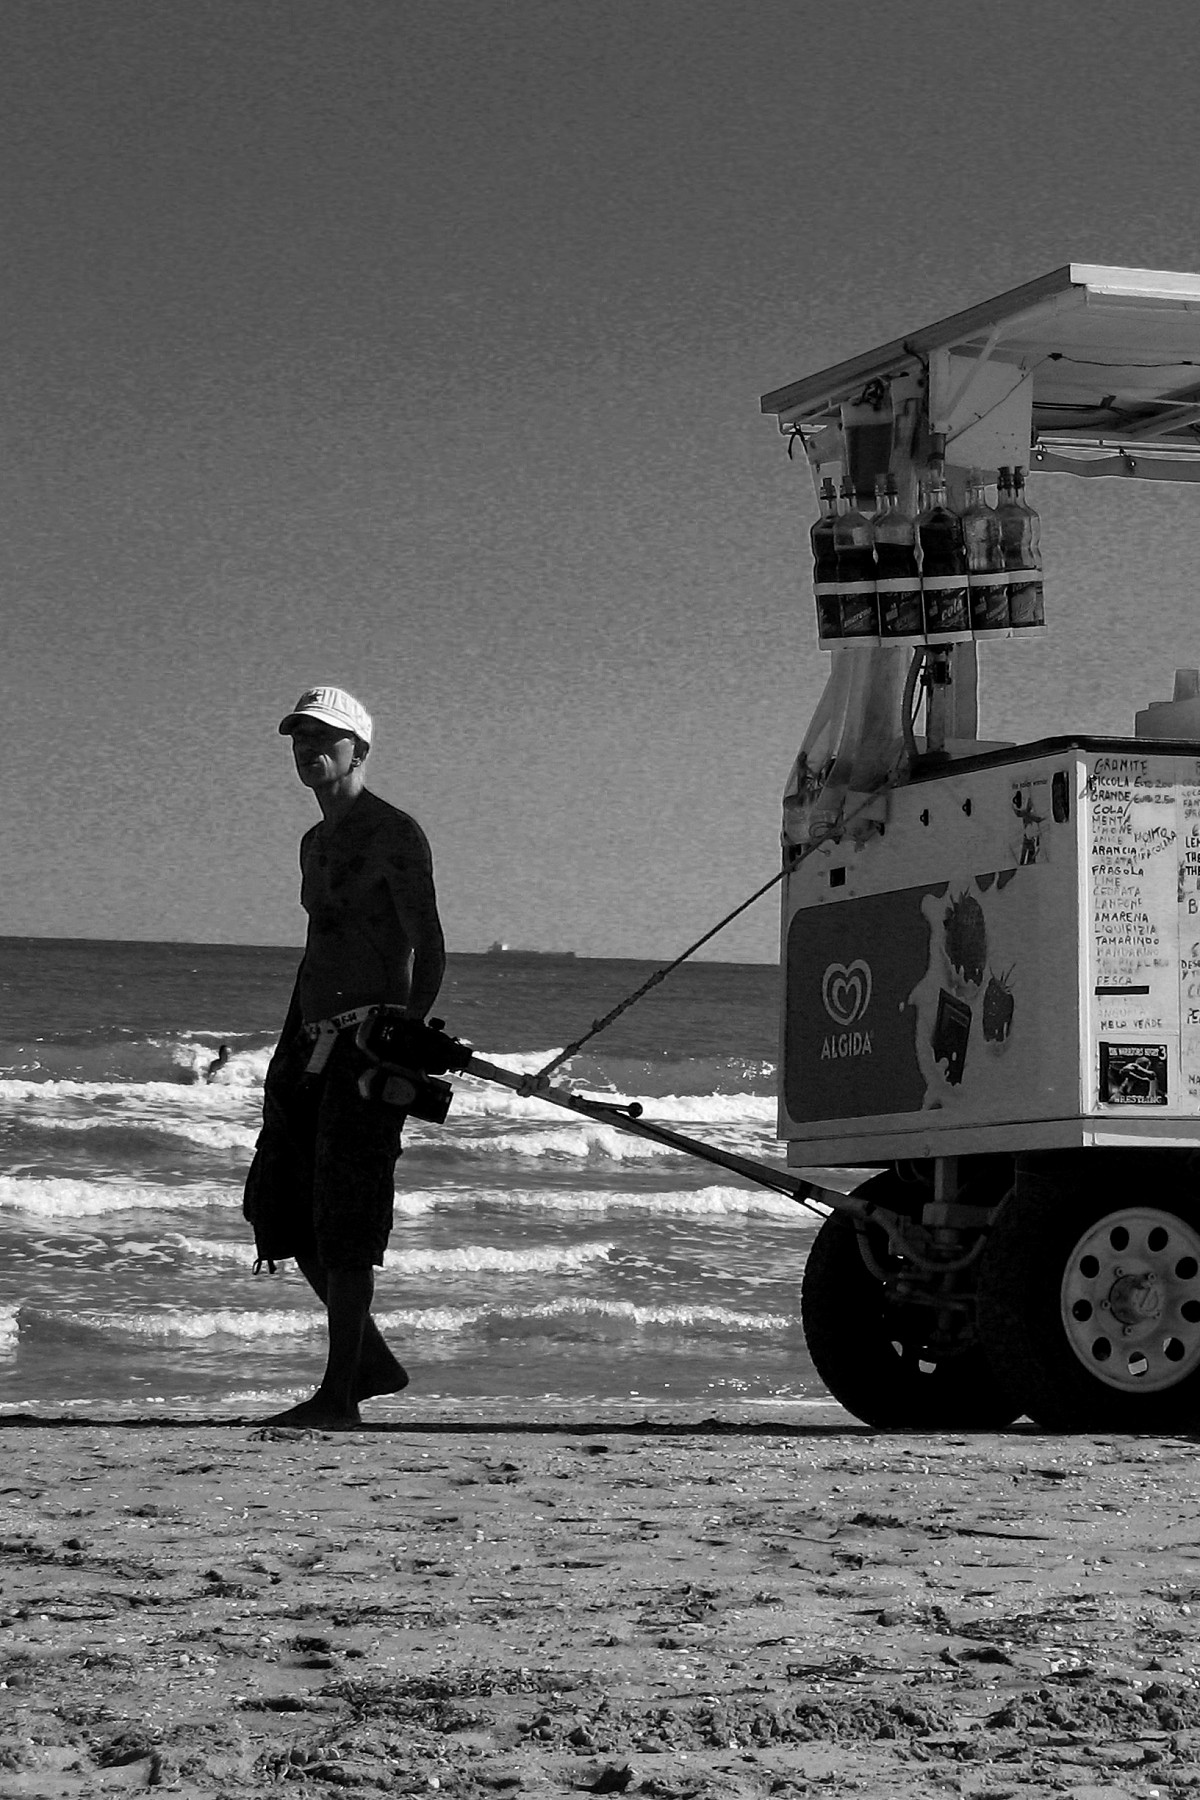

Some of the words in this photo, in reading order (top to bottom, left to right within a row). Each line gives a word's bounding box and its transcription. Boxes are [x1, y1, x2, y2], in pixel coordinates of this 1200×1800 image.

[1090, 789, 1132, 802] GRANDE
[1093, 804, 1123, 814] COLA
[1092, 825, 1132, 835] LIMONE
[1091, 845, 1138, 856] ARANCIA
[1091, 864, 1145, 877] FRAGOLA
[1094, 876, 1122, 887] LIME
[1094, 910, 1149, 923] AMARENA
[1095, 935, 1160, 947] TAMARINDO
[1096, 975, 1133, 985] PESCA
[820, 1032, 872, 1060] ALGIDA
[1158, 1045, 1167, 1061] 3
